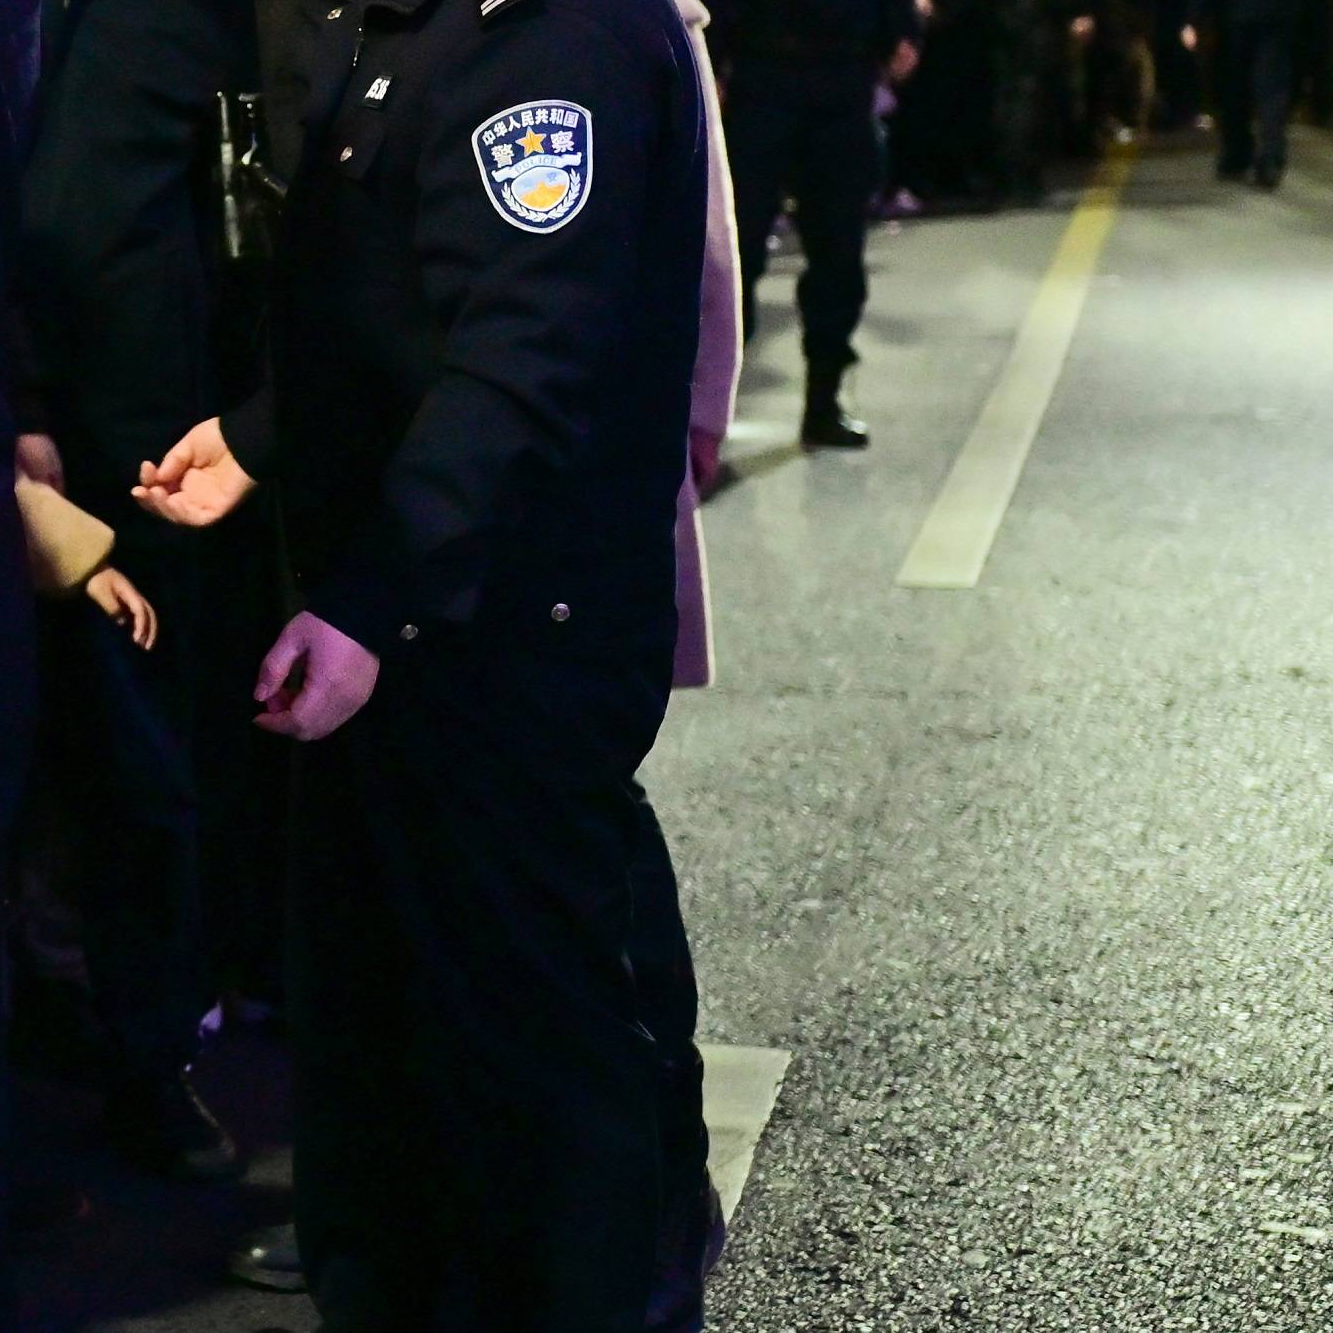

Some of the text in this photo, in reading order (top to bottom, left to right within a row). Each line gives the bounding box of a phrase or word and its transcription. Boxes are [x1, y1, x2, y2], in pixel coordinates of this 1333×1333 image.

[482, 108, 580, 146] 中华人民共和国
